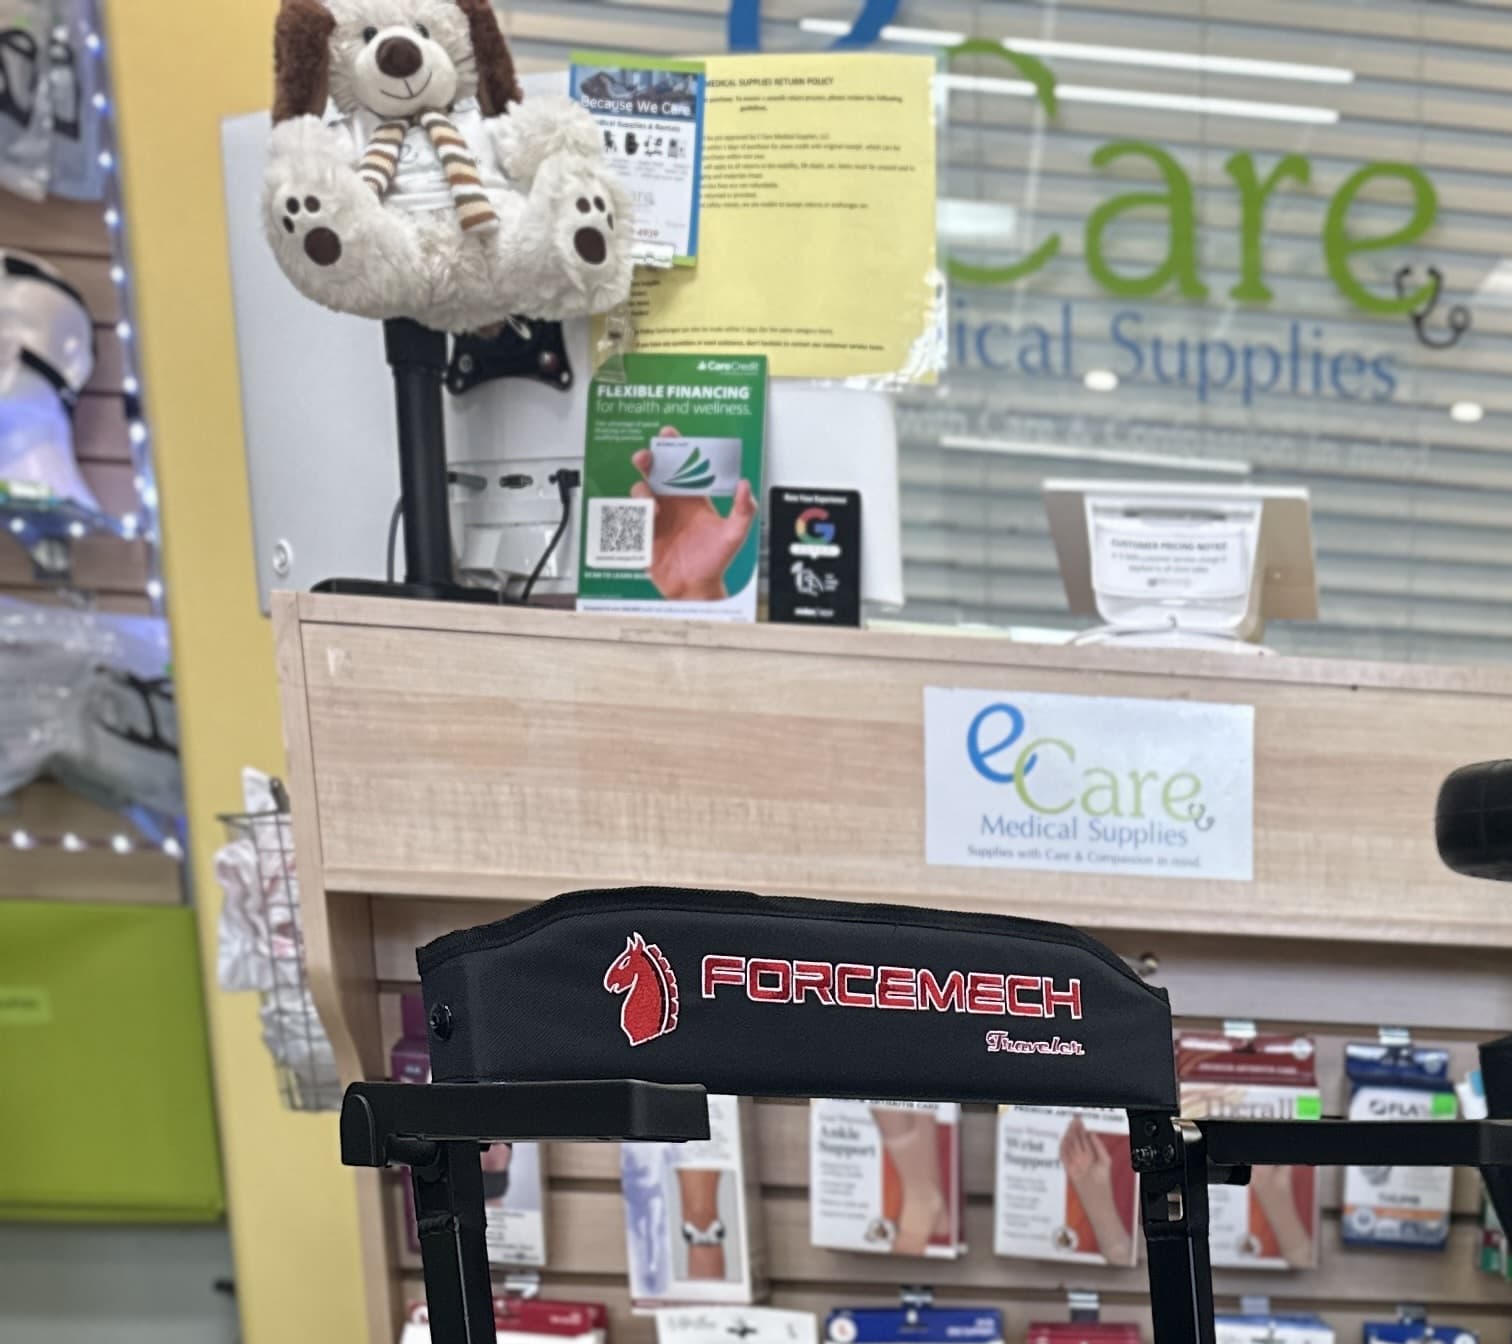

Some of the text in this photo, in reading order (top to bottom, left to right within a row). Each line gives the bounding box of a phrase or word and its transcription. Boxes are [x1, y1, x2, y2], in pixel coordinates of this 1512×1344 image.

[807, 76, 834, 86] POLICY
[637, 100, 658, 114] We
[662, 102, 692, 116] Care
[708, 362, 759, 372] CareCredit
[1109, 310, 1400, 406] Supplies
[597, 384, 749, 400] FLEXIBLE FINANCING
[595, 400, 753, 416] for health and wellness.
[967, 702, 1202, 822] eCare
[980, 813, 1189, 849] Medical Supplies
[967, 845, 1014, 860] Supplies
[1017, 847, 1042, 860] with
[1045, 848, 1071, 862] Care
[1087, 852, 1154, 867] Compassion
[701, 953, 1083, 1019] FORCEMECH
[985, 1029, 1086, 1057] Traveler
[820, 1125, 861, 1141] Ankle
[818, 1140, 877, 1160] Support
[1005, 1137, 1045, 1153] Wrist
[1005, 1153, 1060, 1171] Support
